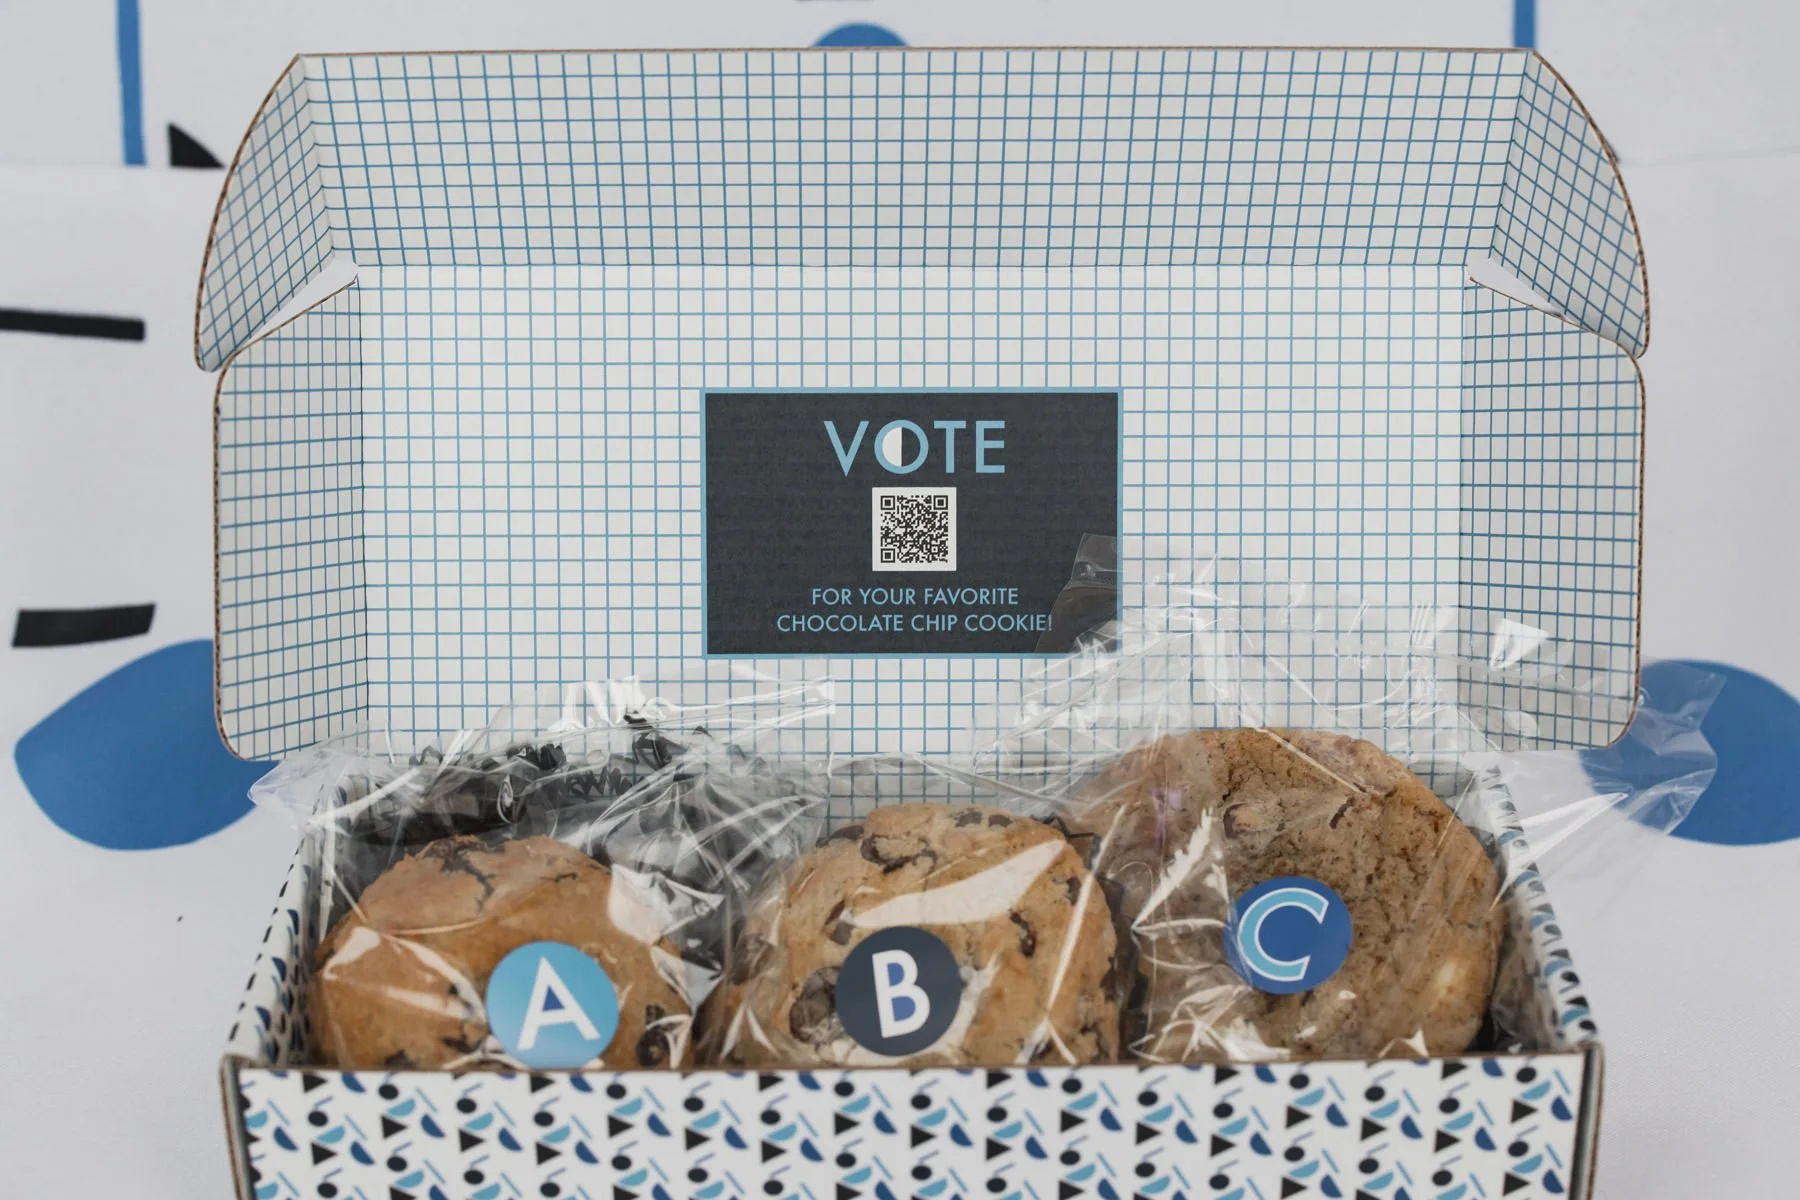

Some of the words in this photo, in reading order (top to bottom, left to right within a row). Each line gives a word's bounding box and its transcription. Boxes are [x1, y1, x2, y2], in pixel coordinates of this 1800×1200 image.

[824, 419, 1005, 476] VOTE
[776, 614, 904, 632] CHOCOLATE
[911, 614, 958, 632] CHIP
[964, 614, 1053, 632] COOKIE!
[812, 588, 852, 606] FOR
[859, 588, 917, 606] YOUR
[924, 588, 1019, 606] FAVORITE
[1236, 887, 1330, 982] C
[516, 956, 600, 1050] A
[872, 949, 931, 1038] B
